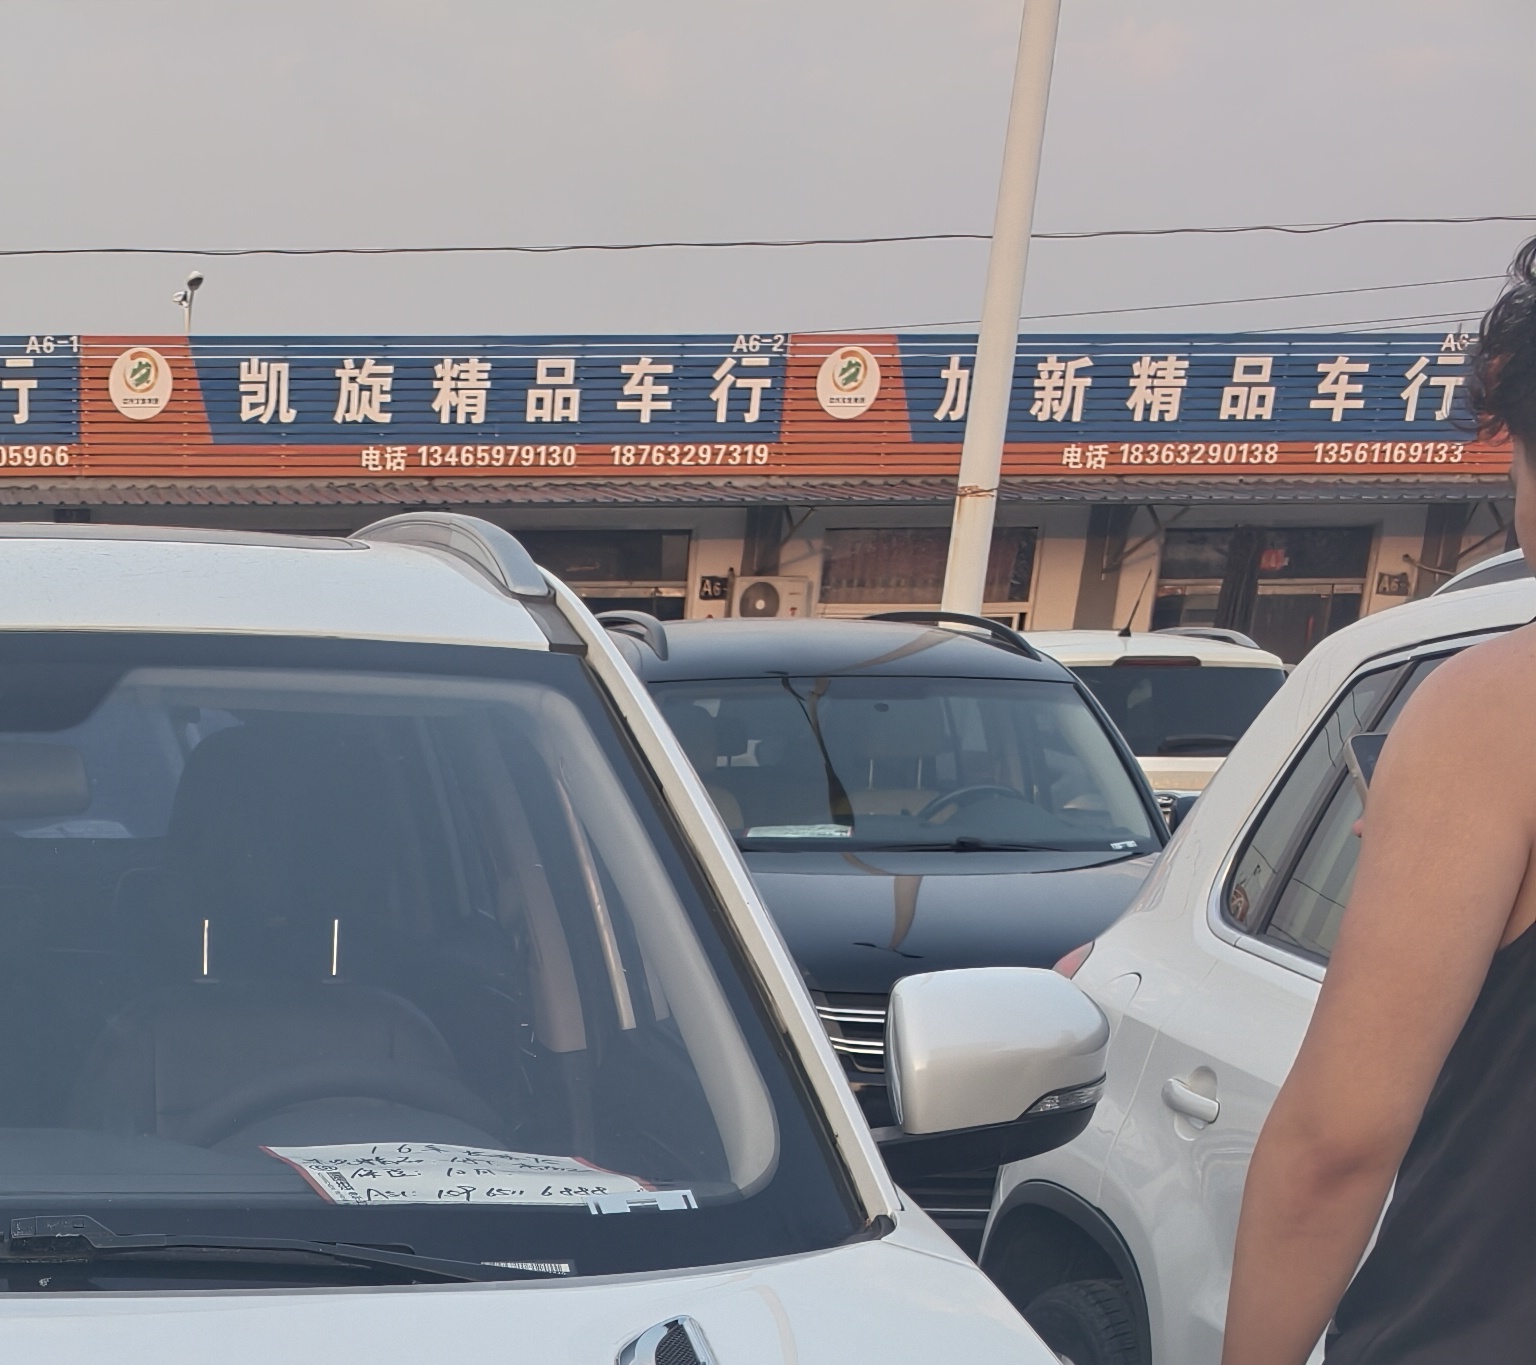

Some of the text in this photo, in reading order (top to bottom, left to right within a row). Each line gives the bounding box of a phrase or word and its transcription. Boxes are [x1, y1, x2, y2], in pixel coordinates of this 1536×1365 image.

[25, 335, 81, 354] A6-1
[732, 334, 786, 353] A6-2
[1440, 333, 1480, 352] A6-
[237, 357, 773, 424] 凯旋精品车行
[360, 443, 769, 472] 电话 13465979130 18763297319
[1062, 442, 1465, 470] 电话 18363290138 13561169133
